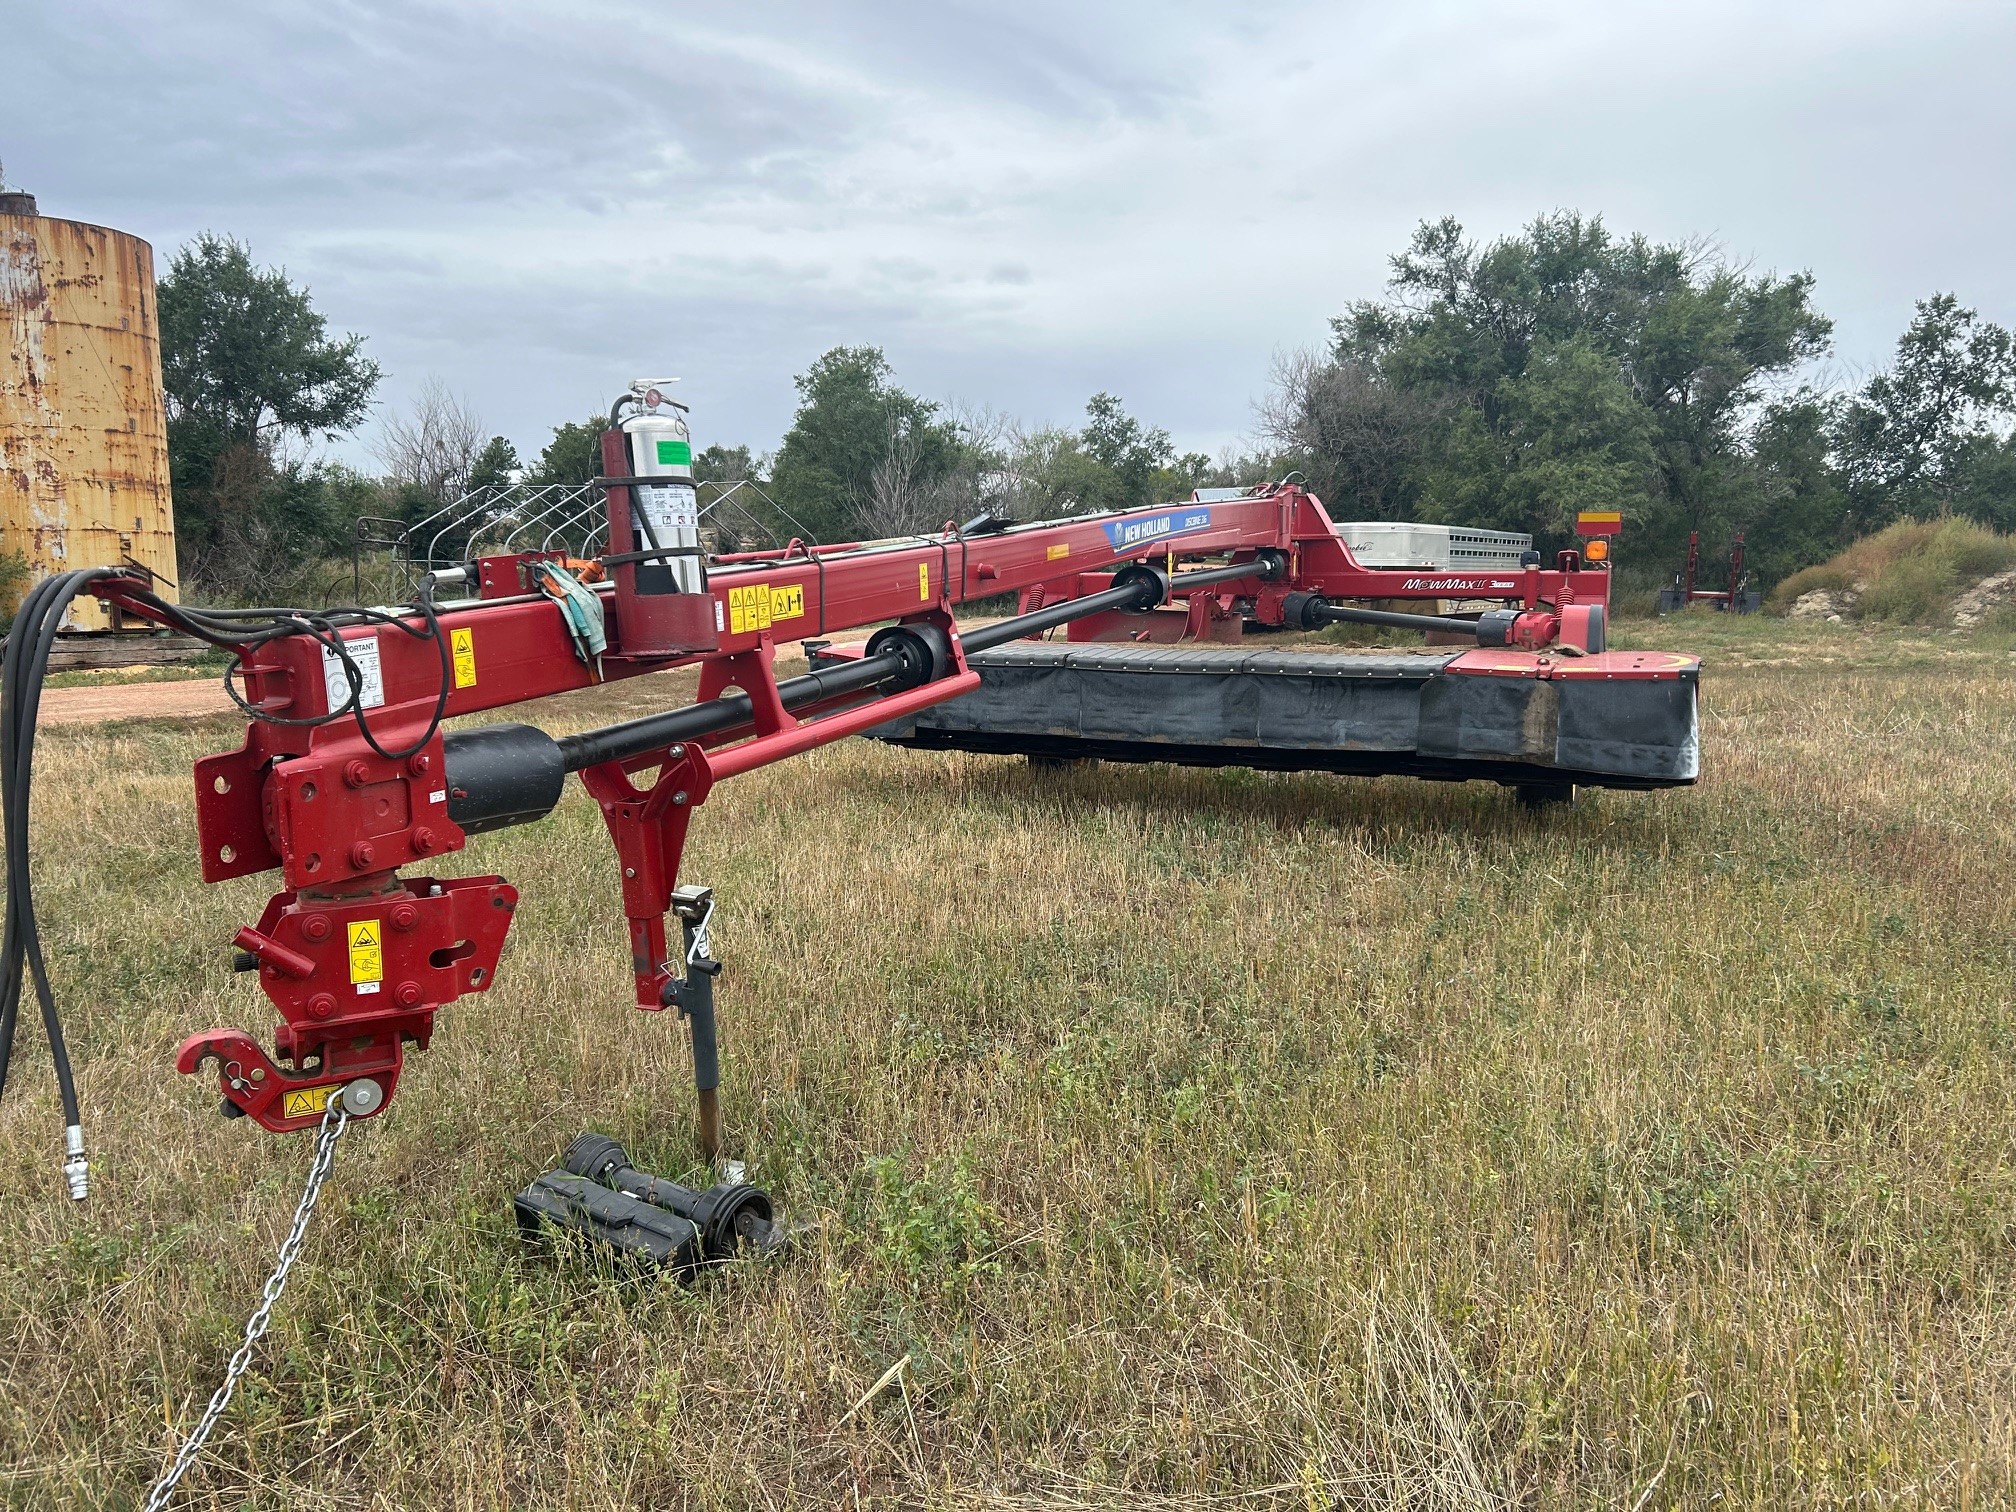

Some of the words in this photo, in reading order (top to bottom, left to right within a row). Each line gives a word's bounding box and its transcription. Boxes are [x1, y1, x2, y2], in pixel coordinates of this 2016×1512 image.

[1125, 523, 1141, 543] NEW
[1142, 517, 1170, 538] HOLLAND
[345, 643, 374, 653] PORTANT
